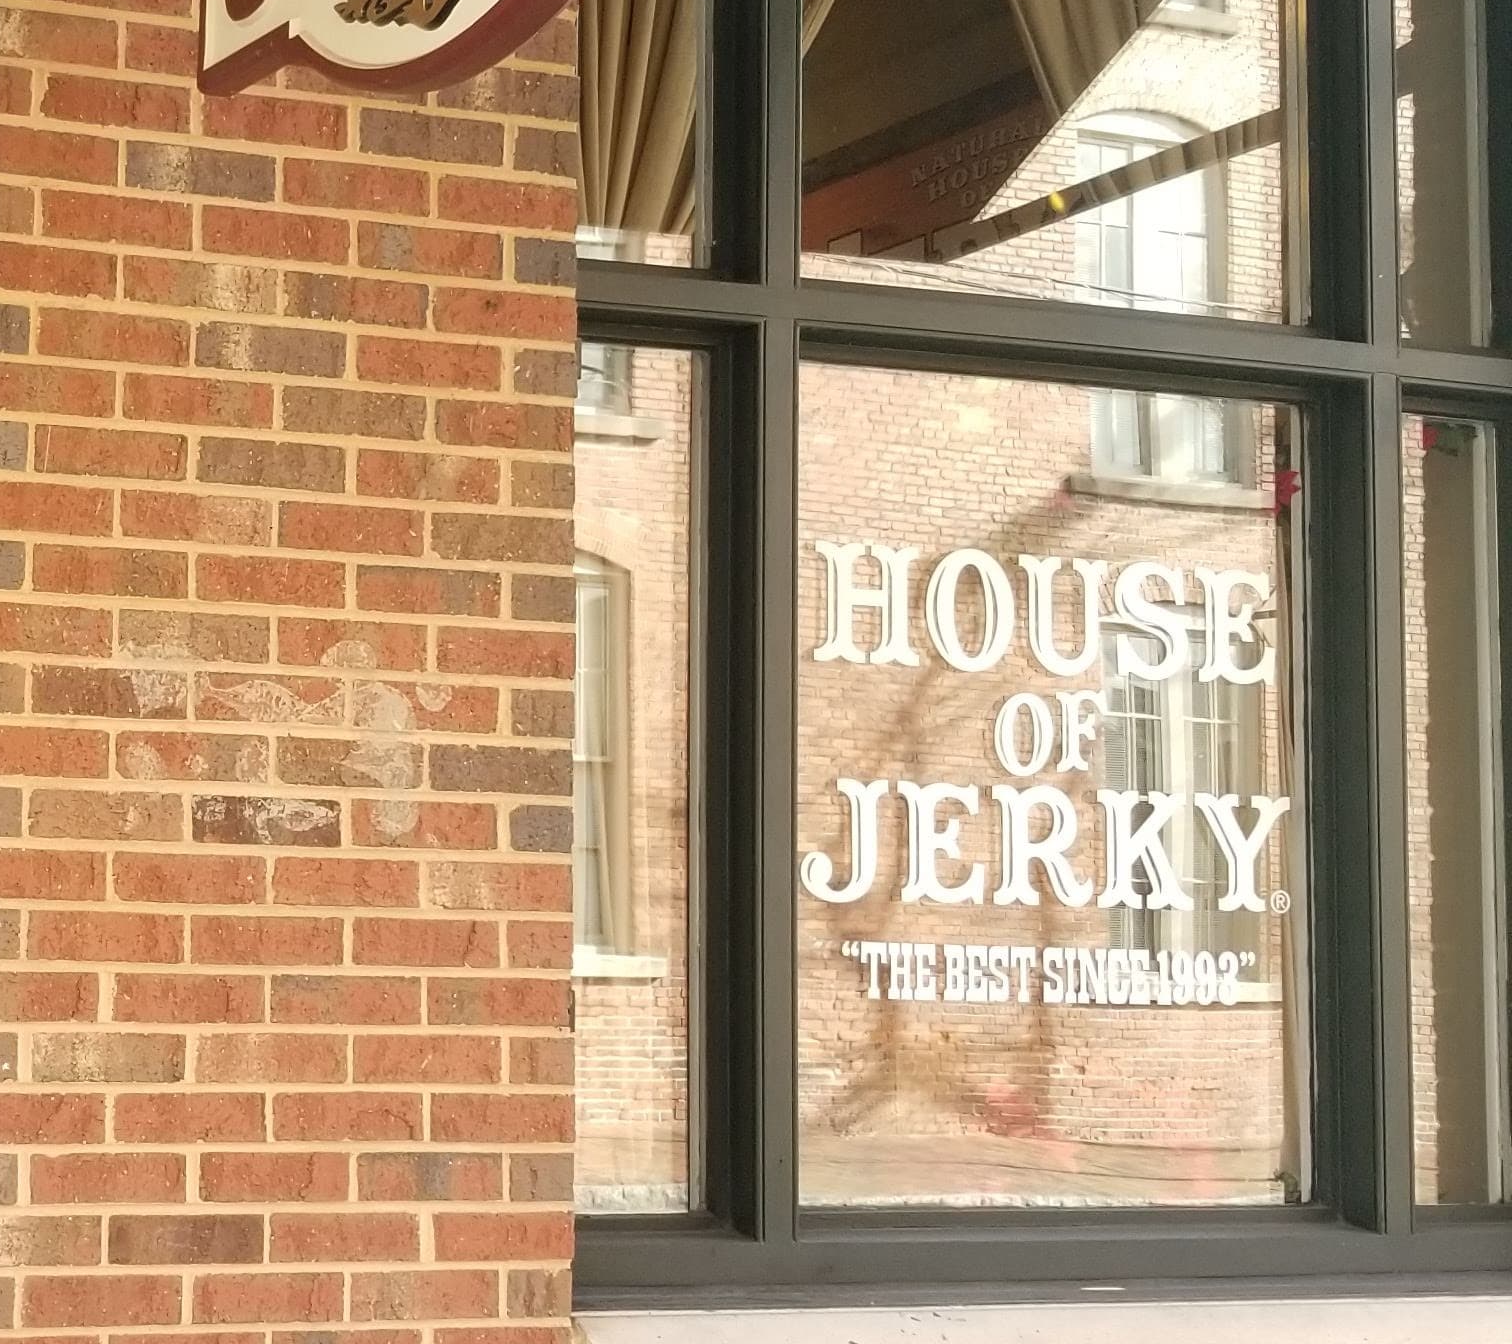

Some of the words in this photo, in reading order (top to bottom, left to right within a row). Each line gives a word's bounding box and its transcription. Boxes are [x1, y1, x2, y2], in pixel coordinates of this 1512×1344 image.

[911, 117, 1048, 188] NATURAL
[813, 539, 1277, 685] HOUSE
[993, 690, 1109, 777] OF
[799, 777, 1291, 913] JERKY
[943, 943, 1036, 1003] BEST
[1042, 946, 1152, 1006] SINCE
